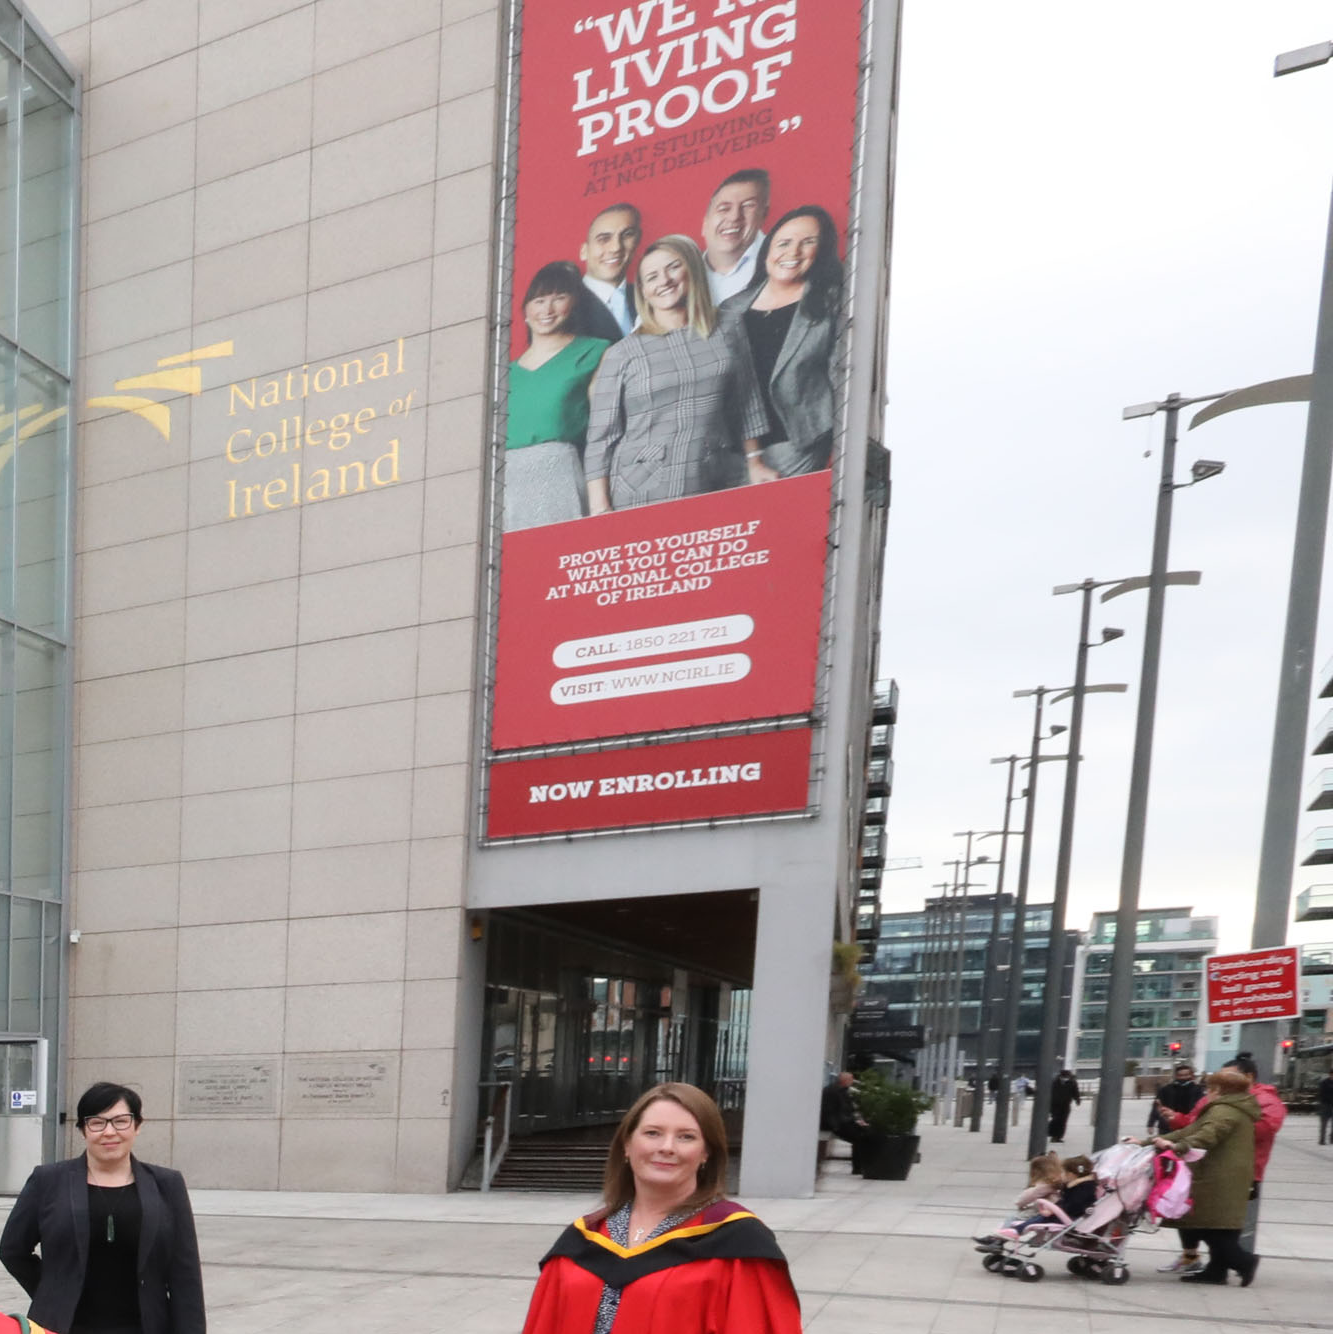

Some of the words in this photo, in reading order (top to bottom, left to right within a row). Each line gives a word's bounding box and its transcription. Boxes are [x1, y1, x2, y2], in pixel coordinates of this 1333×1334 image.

[572, 0, 797, 112] LIVING
[576, 51, 792, 157] PROOF
[588, 146, 645, 176] THAT
[652, 108, 773, 158] STUDYING
[583, 175, 612, 197] AT
[616, 159, 658, 189] NCI
[228, 337, 405, 416] National
[226, 415, 376, 464] College
[389, 387, 417, 418] of
[226, 438, 400, 518] Ireland
[559, 546, 621, 569] PROVE
[624, 540, 652, 555] TO
[654, 520, 761, 551] YOURSELF
[566, 560, 623, 581] WHAT
[626, 552, 666, 572] YOU
[671, 545, 712, 564] CAN
[718, 539, 748, 554] DO
[545, 584, 571, 600] AT
[574, 568, 671, 596] NATIONAL
[675, 550, 770, 578] COLLEGE
[597, 591, 622, 606] OF
[625, 576, 712, 602] IRELAND
[575, 642, 621, 658] CALL:
[625, 635, 664, 651] 1850
[669, 630, 696, 646] 221
[701, 625, 729, 640] 721
[560, 680, 608, 697] VISIT:
[612, 662, 735, 690] WWW.NCIRL.IE
[529, 780, 594, 803] NOW
[598, 762, 761, 796] ENROLLING
[1211, 998, 1231, 1006] are
